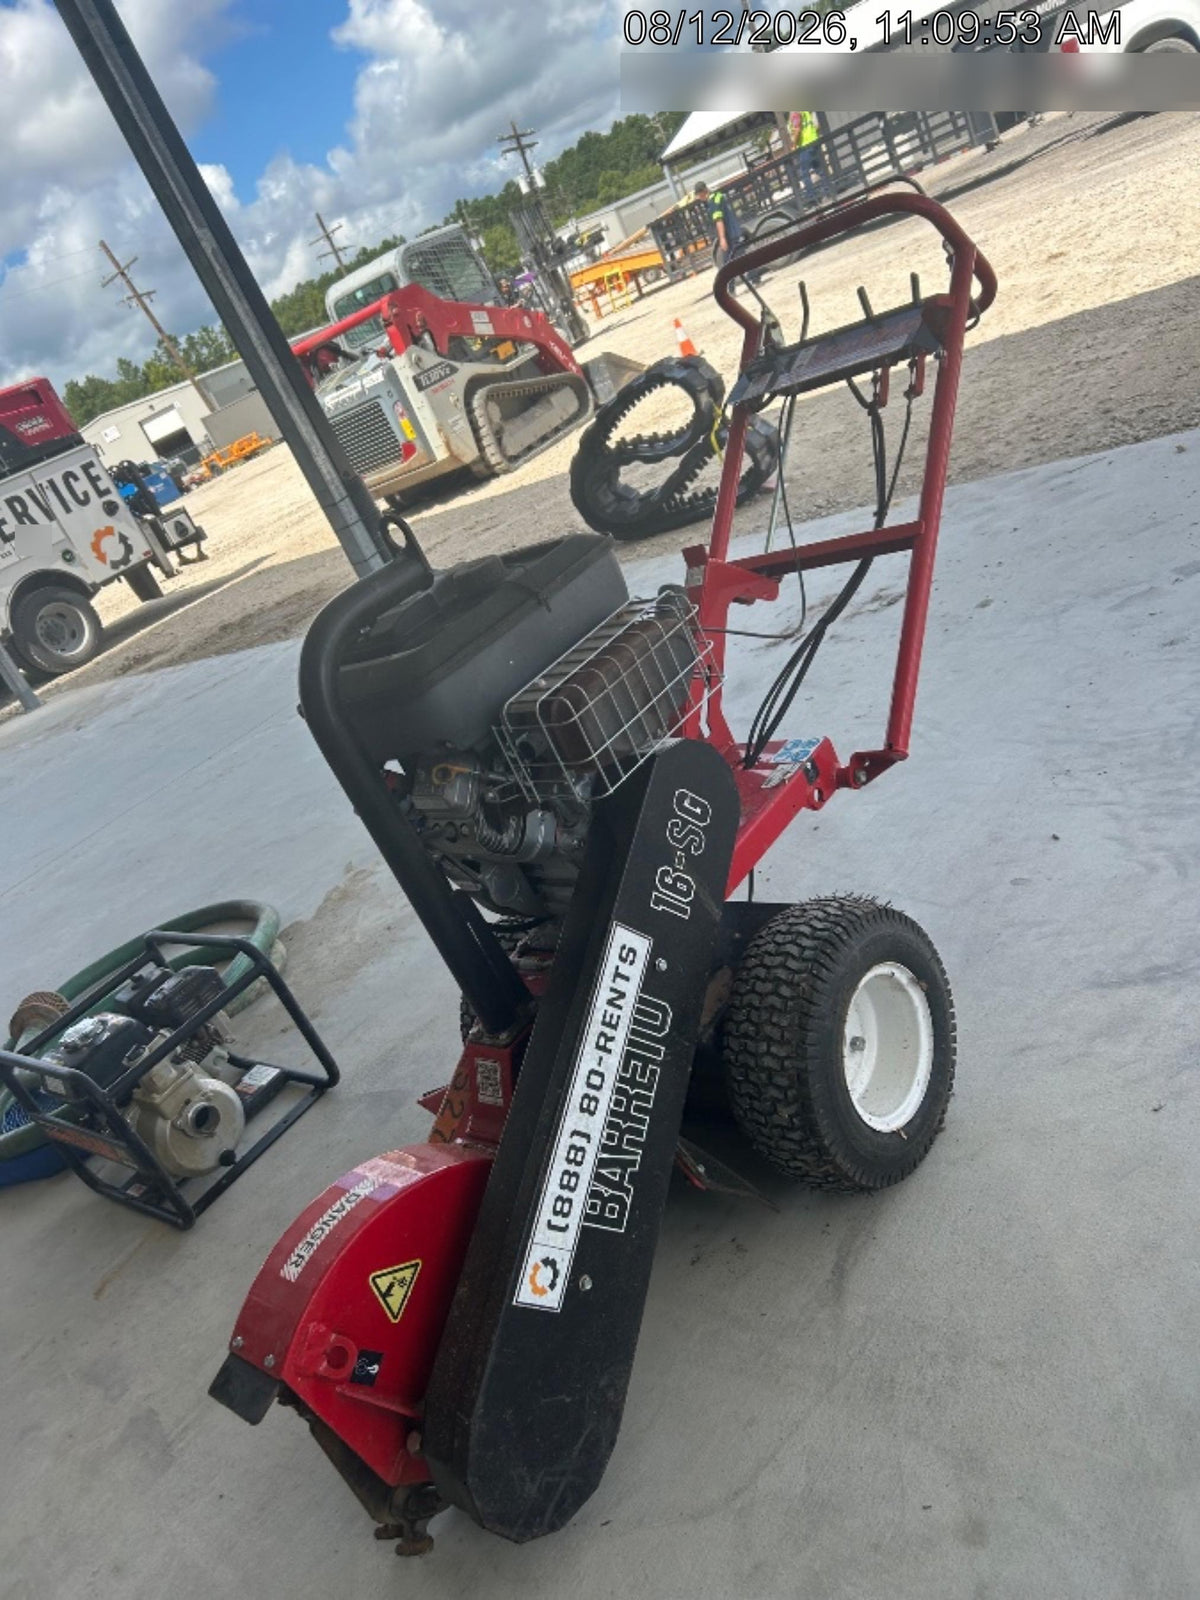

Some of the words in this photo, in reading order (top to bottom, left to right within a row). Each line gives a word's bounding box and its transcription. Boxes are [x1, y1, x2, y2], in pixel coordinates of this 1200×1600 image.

[650, 788, 712, 920] 16-SG
[546, 1128, 591, 1233] (888)
[579, 943, 638, 1117] 80-RENTS
[290, 1192, 361, 1268] DANGER
